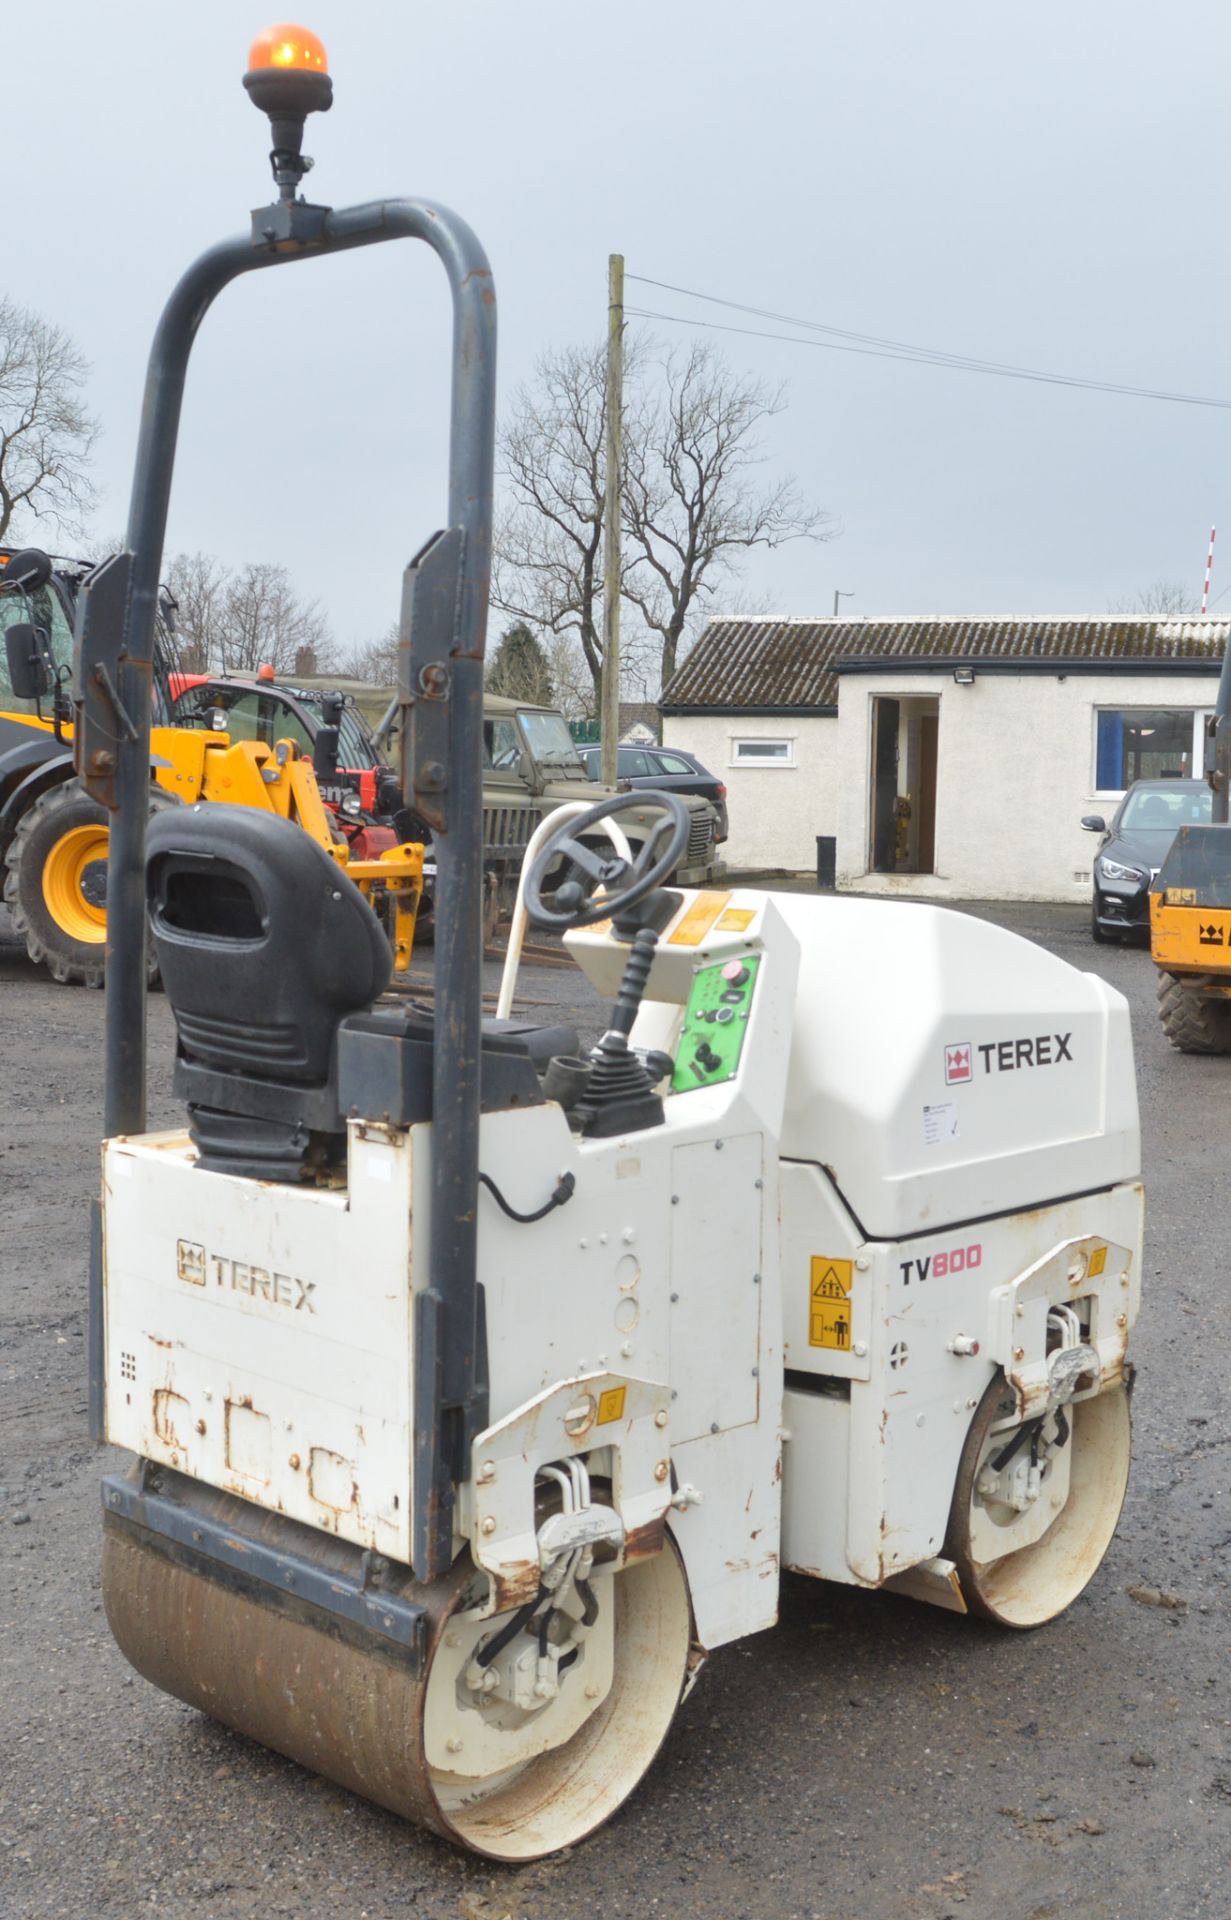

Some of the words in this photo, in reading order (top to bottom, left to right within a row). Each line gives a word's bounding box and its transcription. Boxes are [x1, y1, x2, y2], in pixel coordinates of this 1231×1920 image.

[978, 1032, 1073, 1074] TEREX
[211, 1254, 318, 1315] TEREX
[900, 1243, 982, 1286] TV800
